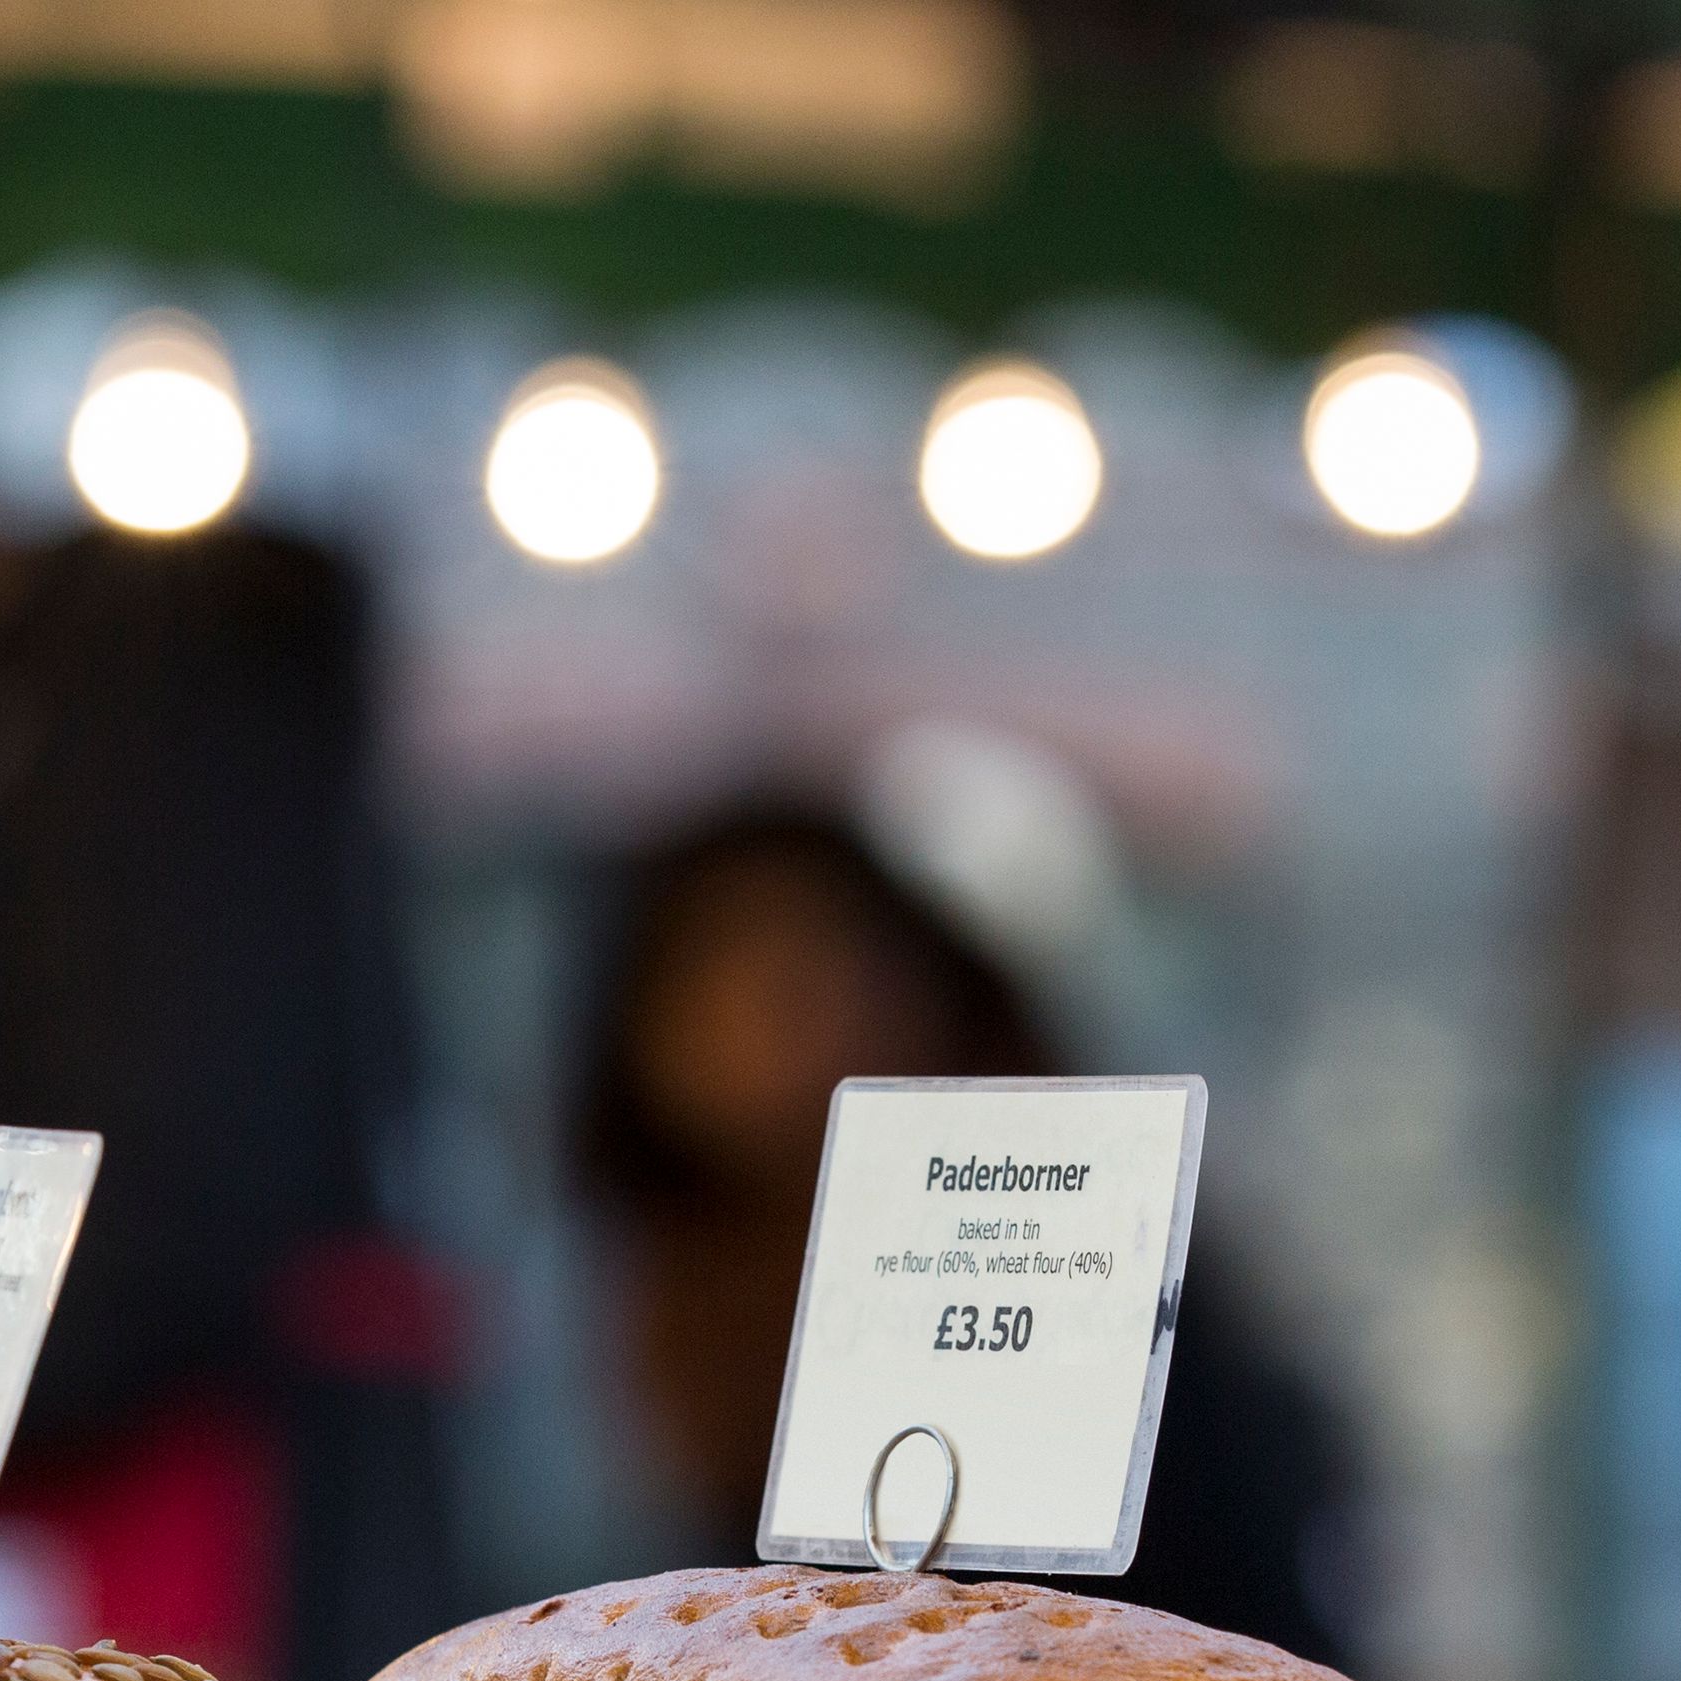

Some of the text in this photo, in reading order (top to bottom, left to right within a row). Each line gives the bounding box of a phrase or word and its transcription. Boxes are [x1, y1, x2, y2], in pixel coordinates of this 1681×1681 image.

[926, 1155, 1090, 1192] Paderborner
[958, 1218, 1041, 1240] baked in tin
[874, 1250, 1113, 1279] rye flour (60%, wheat flour (40%)
[934, 1305, 1033, 1352] £3.50
